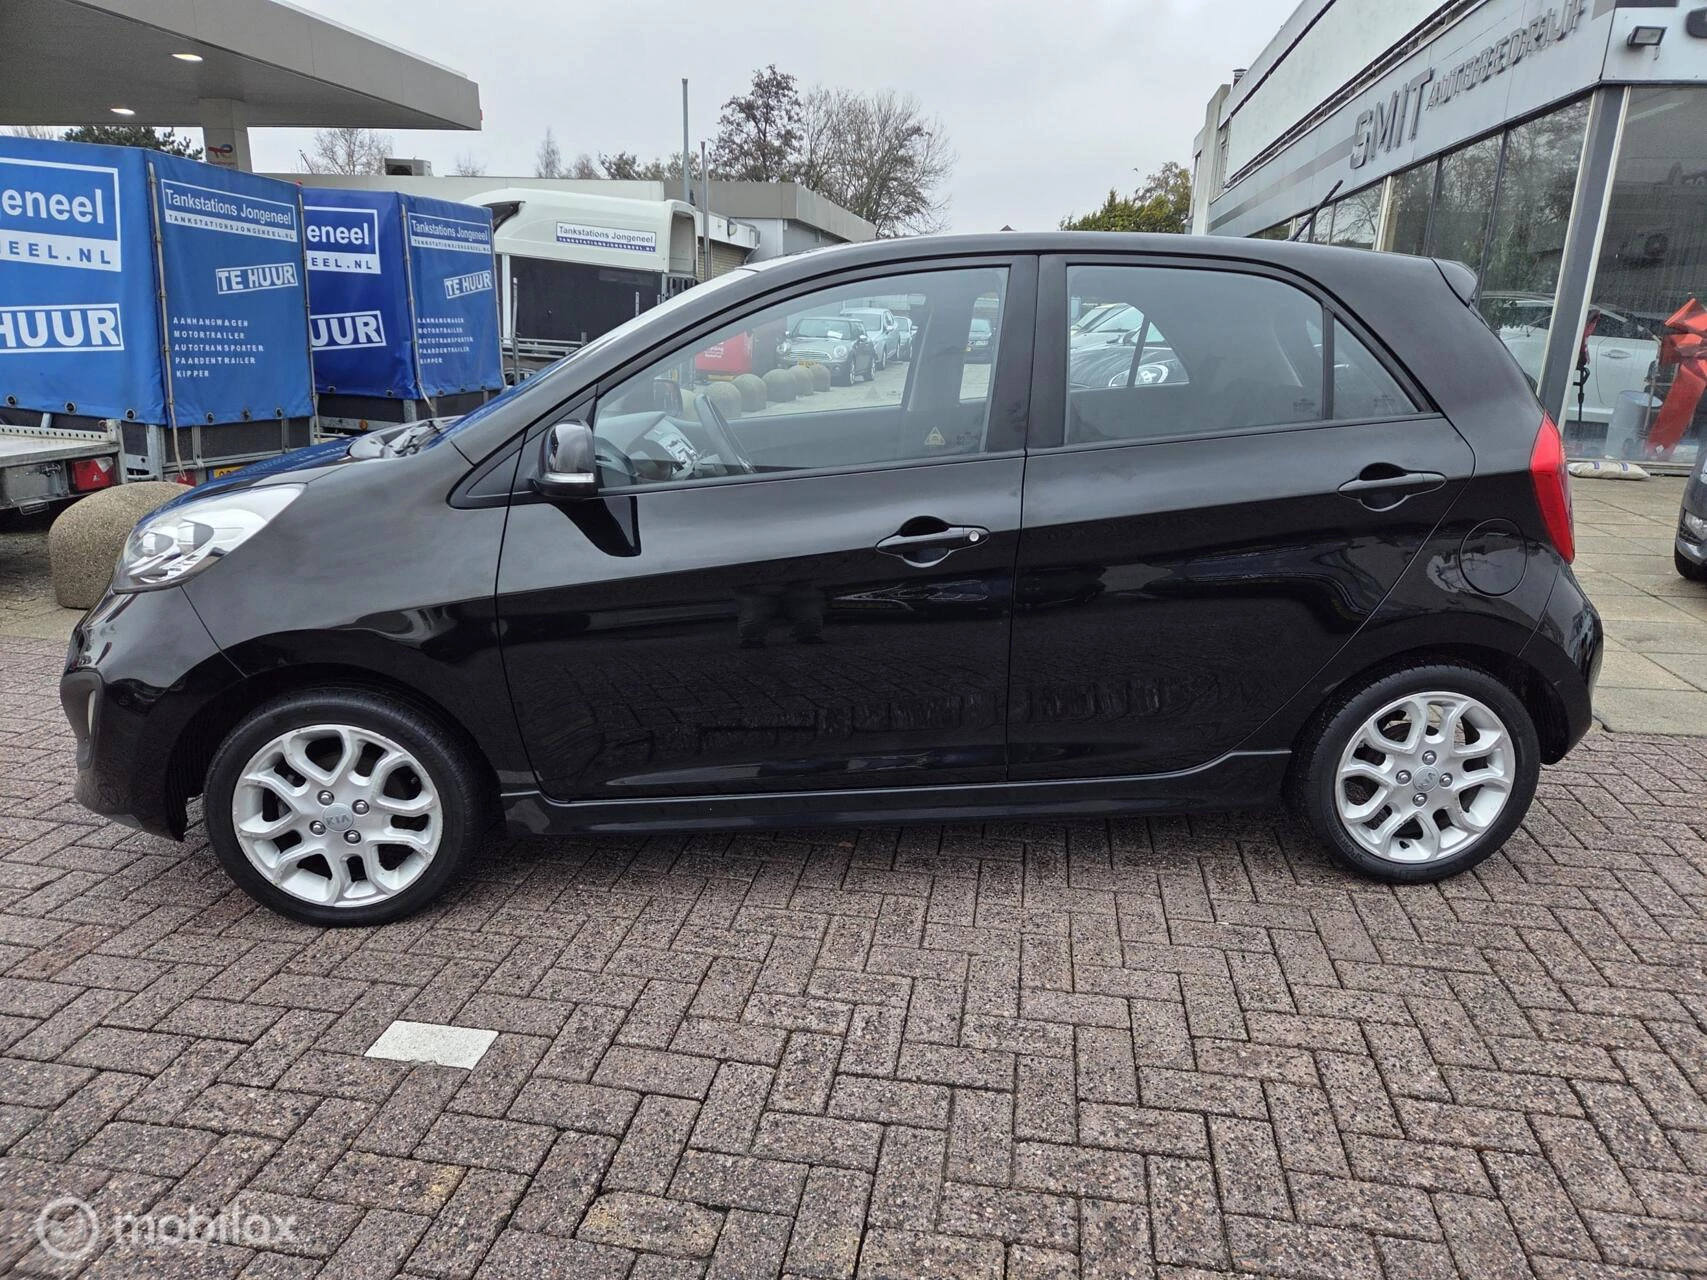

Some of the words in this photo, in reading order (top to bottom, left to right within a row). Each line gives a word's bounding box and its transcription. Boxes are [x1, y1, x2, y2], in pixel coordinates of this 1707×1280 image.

[1350, 67, 1433, 169] SMIT
[165, 188, 238, 216] Tankstations
[240, 204, 292, 225] Jongeneel
[411, 220, 456, 238] Tankstations
[457, 227, 488, 242] Jongeneel
[559, 226, 610, 239] Tankstations
[611, 231, 653, 243] Jongeneel
[218, 270, 243, 291] TE
[248, 265, 296, 288] HUUR
[445, 279, 460, 296] TE
[462, 272, 492, 292] HUUR
[173, 330, 245, 339] MOTORTRAILER
[174, 344, 264, 352] AUTOTRANSPORTER
[176, 370, 209, 378] KIPPER
[326, 814, 350, 825] KIA
